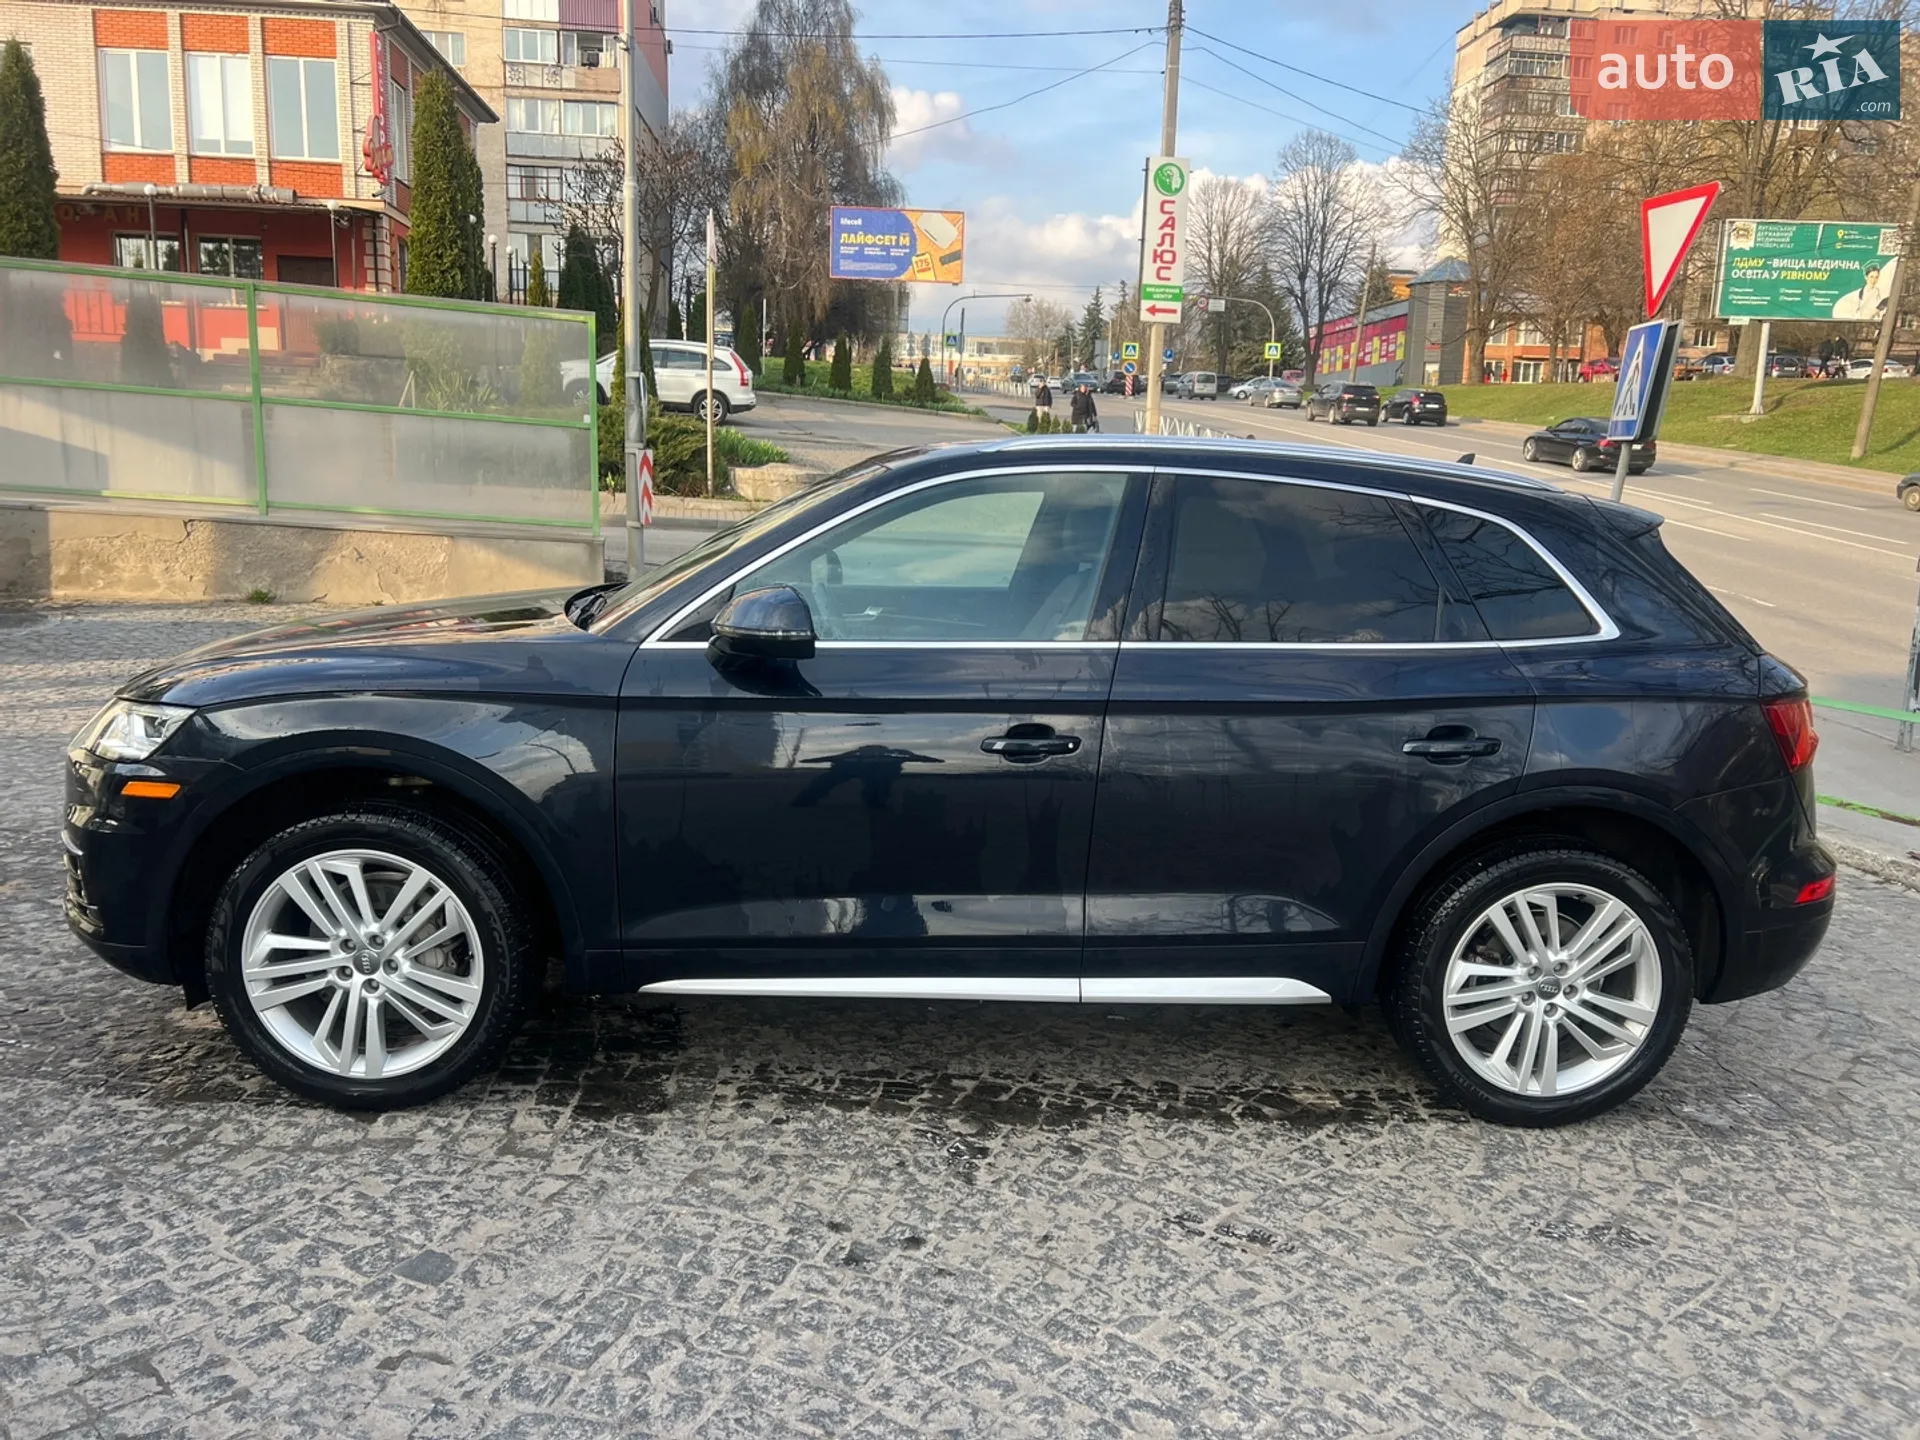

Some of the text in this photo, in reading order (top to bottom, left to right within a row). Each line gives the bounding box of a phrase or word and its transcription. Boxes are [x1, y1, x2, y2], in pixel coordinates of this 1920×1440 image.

[376, 38, 389, 180] РЕСТОРН
[840, 231, 897, 246] ЛАЙФСЕТ
[1152, 199, 1177, 281] САЛЮС
[1732, 257, 1765, 268] ЛДМУ
[1807, 259, 1860, 270] МЕДИЧНА
[1731, 270, 1830, 281] ОСВІТА У РІВНОМУ
